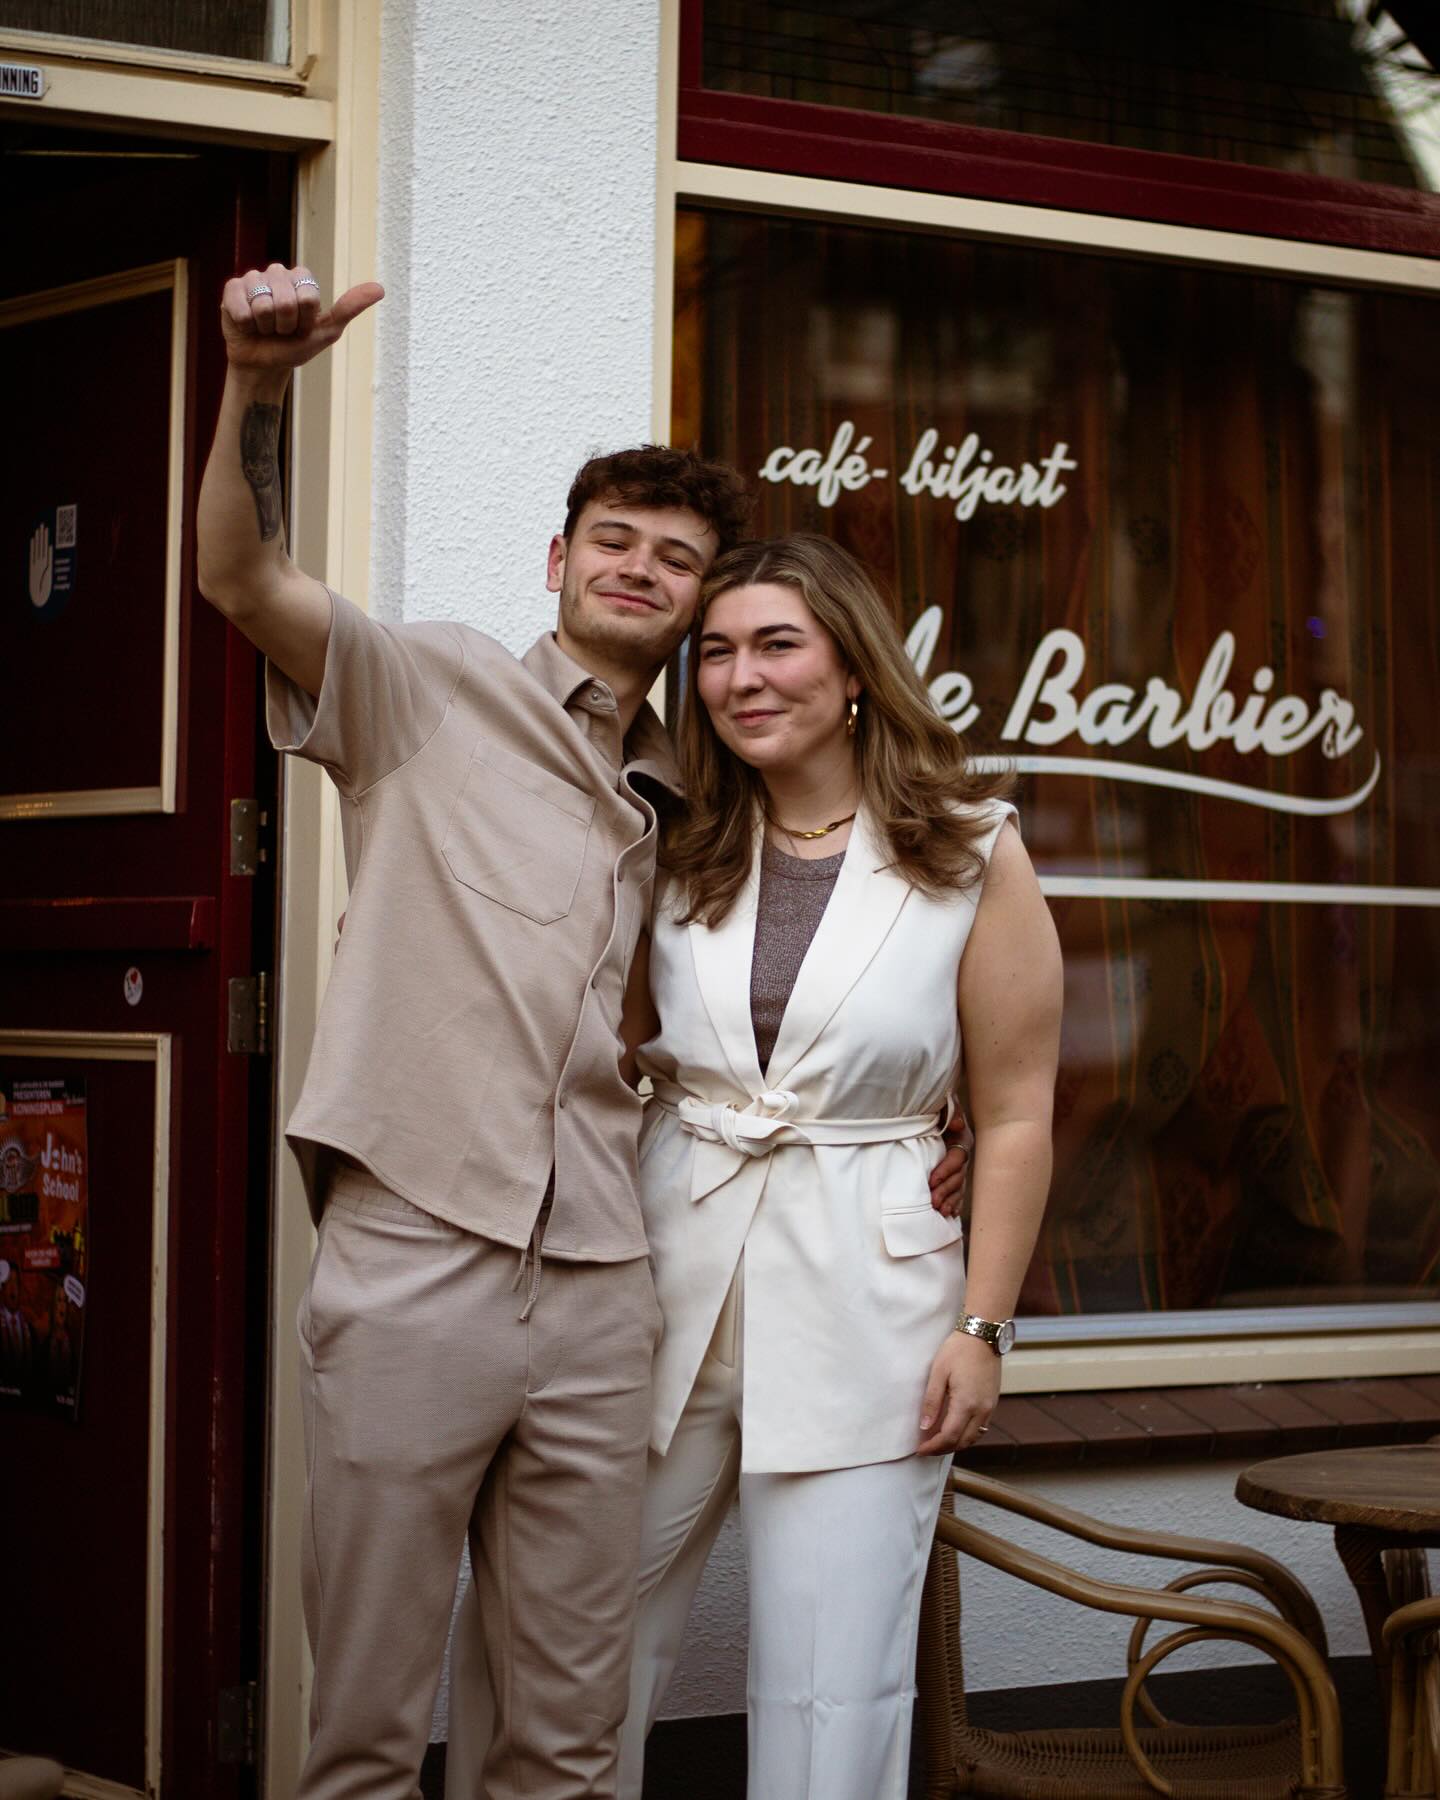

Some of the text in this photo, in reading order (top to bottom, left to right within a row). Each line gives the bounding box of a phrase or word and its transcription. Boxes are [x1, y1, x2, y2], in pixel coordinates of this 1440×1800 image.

[0, 67, 39, 94] NNING
[759, 421, 1077, 521] café- biljart
[1001, 629, 1363, 759] Barbier
